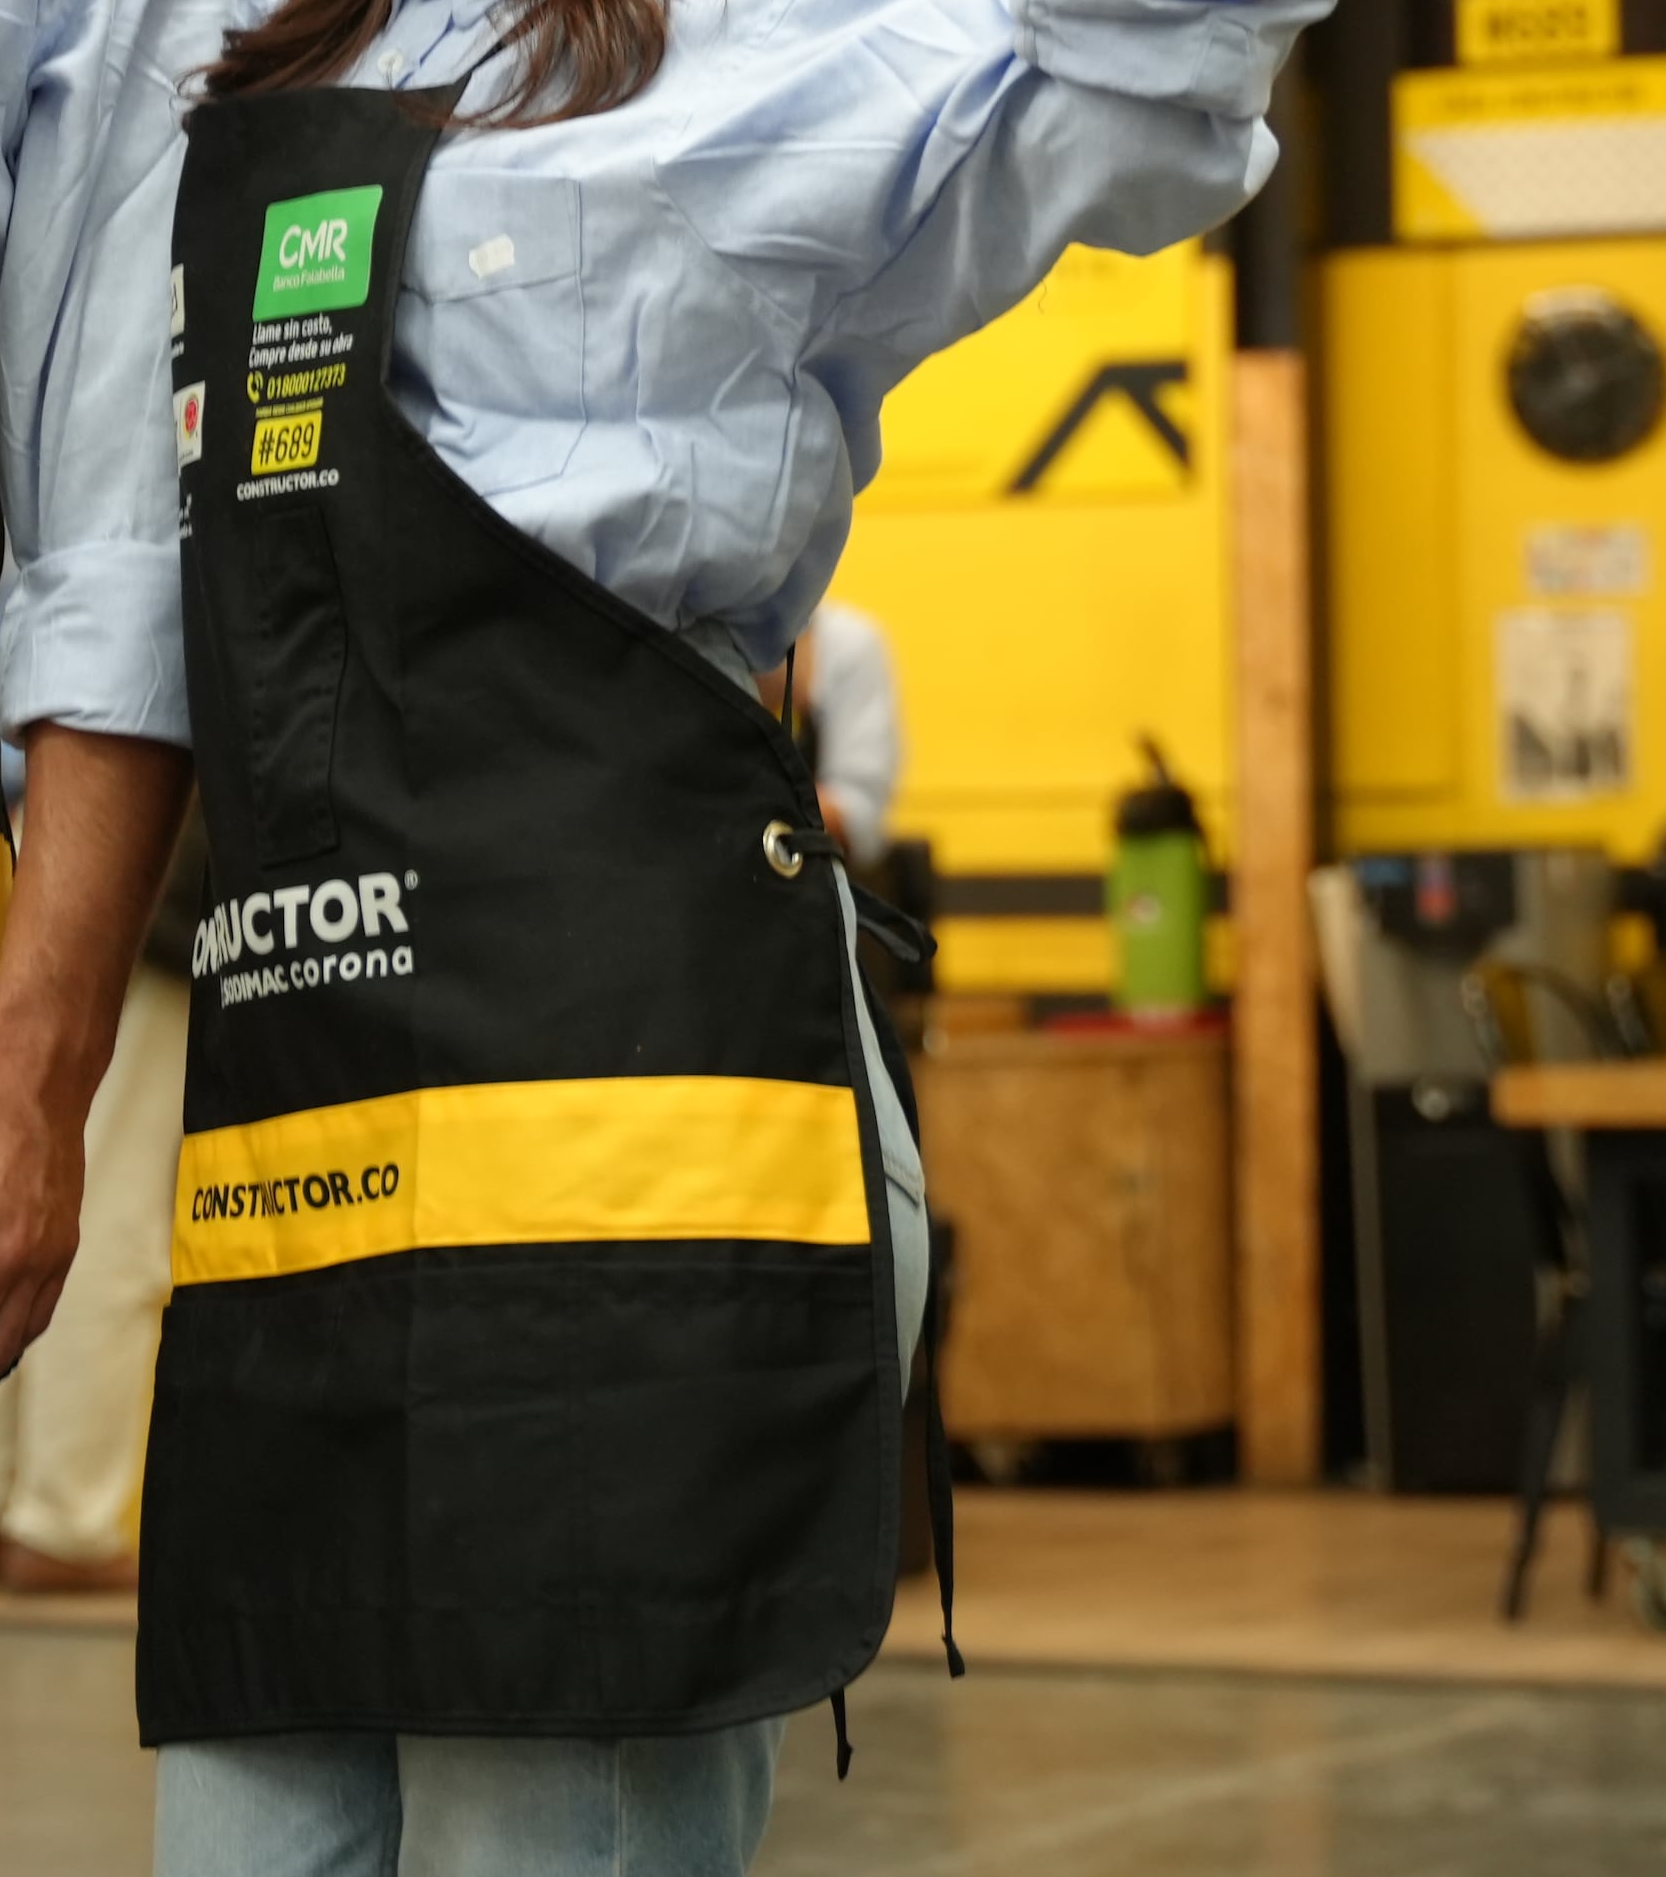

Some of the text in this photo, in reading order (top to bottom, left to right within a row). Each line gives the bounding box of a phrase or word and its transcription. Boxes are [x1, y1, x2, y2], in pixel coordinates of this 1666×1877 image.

[279, 217, 348, 269] CMR
[301, 266, 345, 287] Falabella
[248, 332, 353, 369] Compre desde su obra
[252, 322, 282, 346] Llame
[284, 318, 299, 341] sin
[267, 362, 346, 400] 018000127373
[258, 422, 314, 467] #689
[236, 468, 339, 501] CONSTRUCTOR.CO
[223, 946, 414, 1007] SODIMAC corona
